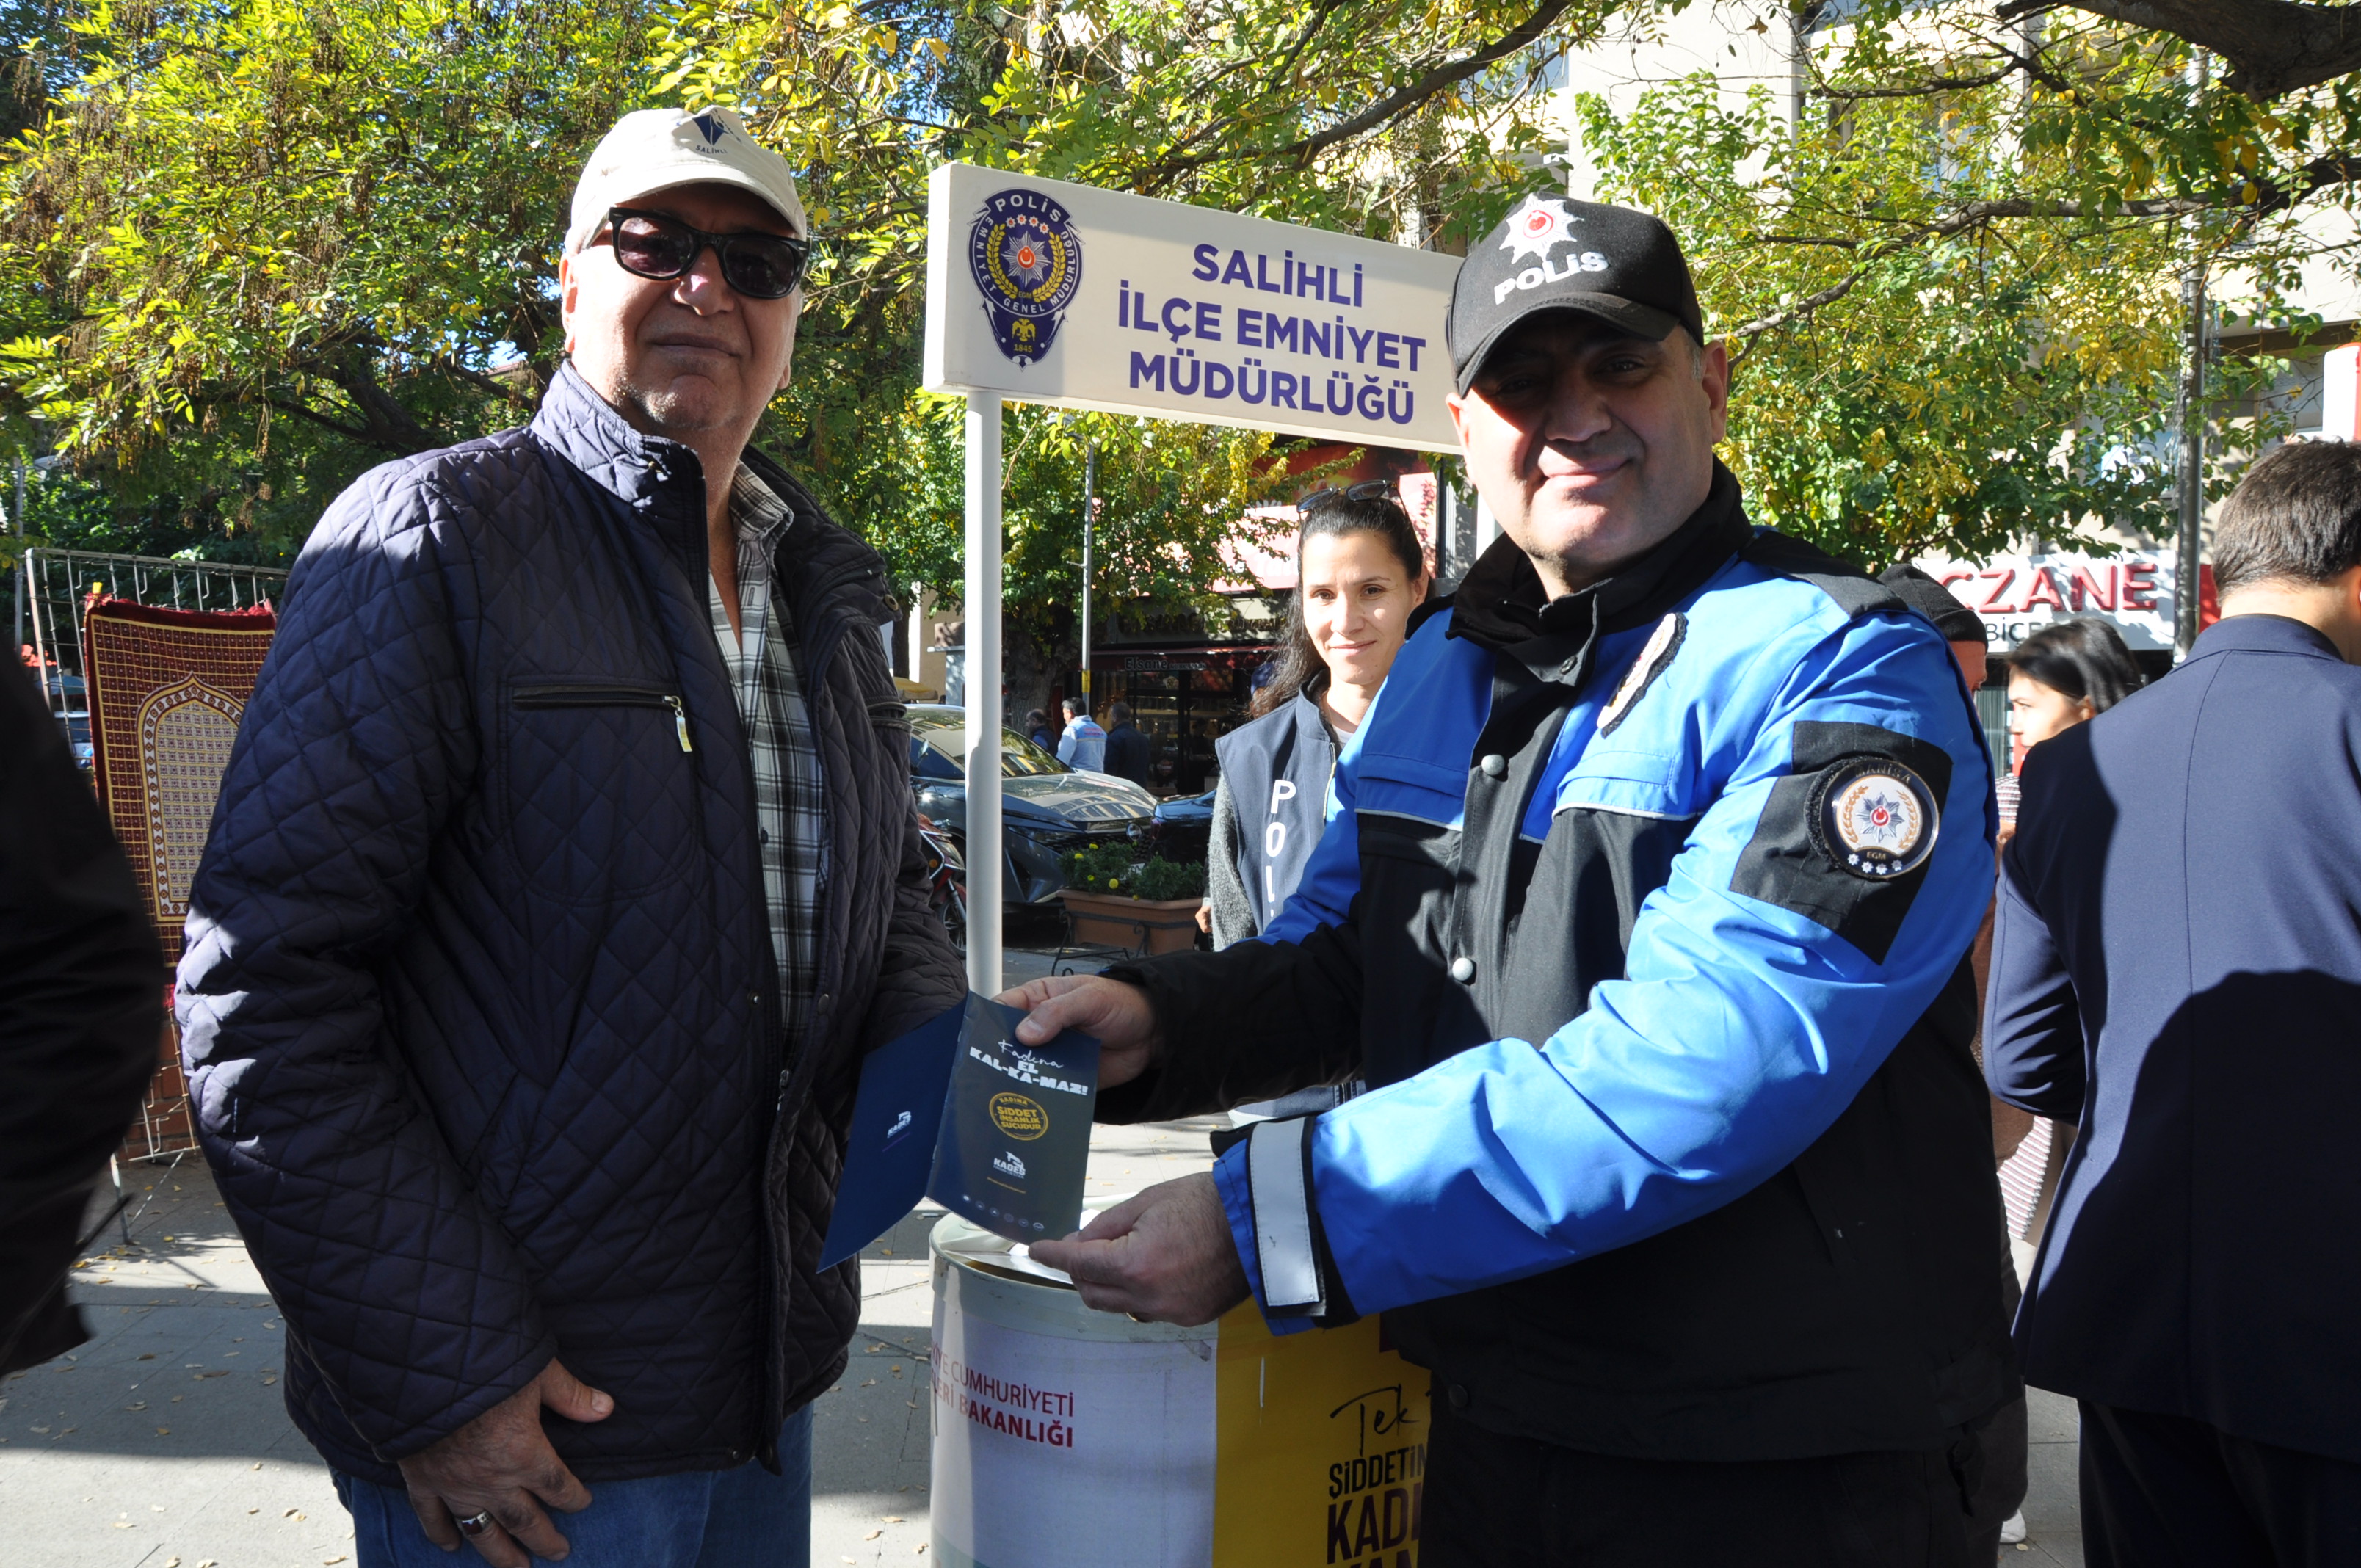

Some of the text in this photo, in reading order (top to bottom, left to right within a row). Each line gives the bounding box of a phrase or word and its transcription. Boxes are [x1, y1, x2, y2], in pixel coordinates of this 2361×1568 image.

[995, 194, 1062, 222] POLİS
[976, 217, 997, 292] EMNİYET
[1004, 297, 1045, 313] GENEL
[1192, 243, 1363, 308] SALİHLİ
[1013, 344, 1033, 353] 1845
[1118, 280, 1426, 371] İLÇE EMNİYET
[1129, 348, 1415, 425] MÜDÜRLÜĞÜ
[1938, 562, 2158, 614] CZANE
[1865, 850, 1887, 861] EGM
[1017, 1060, 1039, 1075] EL
[993, 1157, 1026, 1176] KADES
[951, 1360, 1074, 1418] CUMHURİYETİ
[959, 1393, 1073, 1448] BAKANLIĞI
[1330, 1383, 1421, 1458] Tek
[1327, 1481, 1423, 1565] KADI
